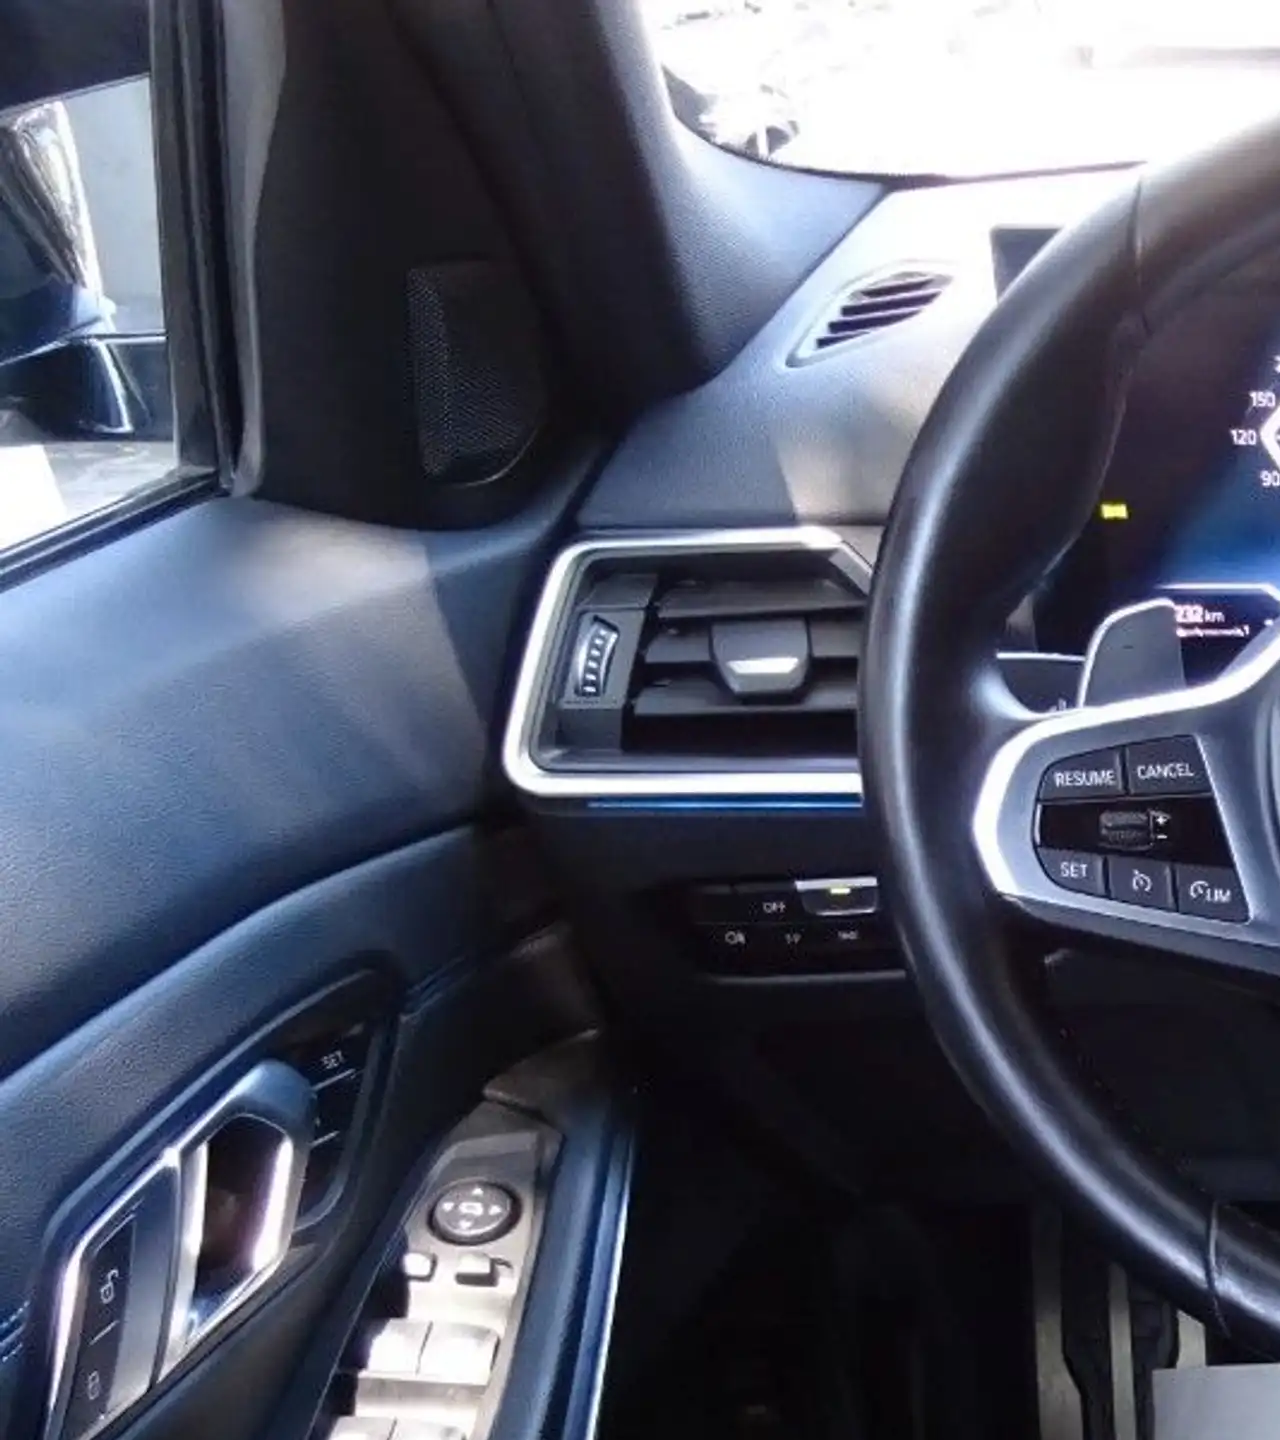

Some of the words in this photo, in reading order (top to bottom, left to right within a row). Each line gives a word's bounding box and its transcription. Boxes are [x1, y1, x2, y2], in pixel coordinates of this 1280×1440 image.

[1250, 391, 1276, 408] 150
[1230, 429, 1258, 446] 120
[1259, 470, 1280, 487] 90
[1204, 608, 1226, 623] km
[1054, 770, 1117, 788] RESUME
[1137, 762, 1195, 780] CANCEL
[1060, 861, 1088, 878] SET
[1206, 888, 1231, 903] LIM
